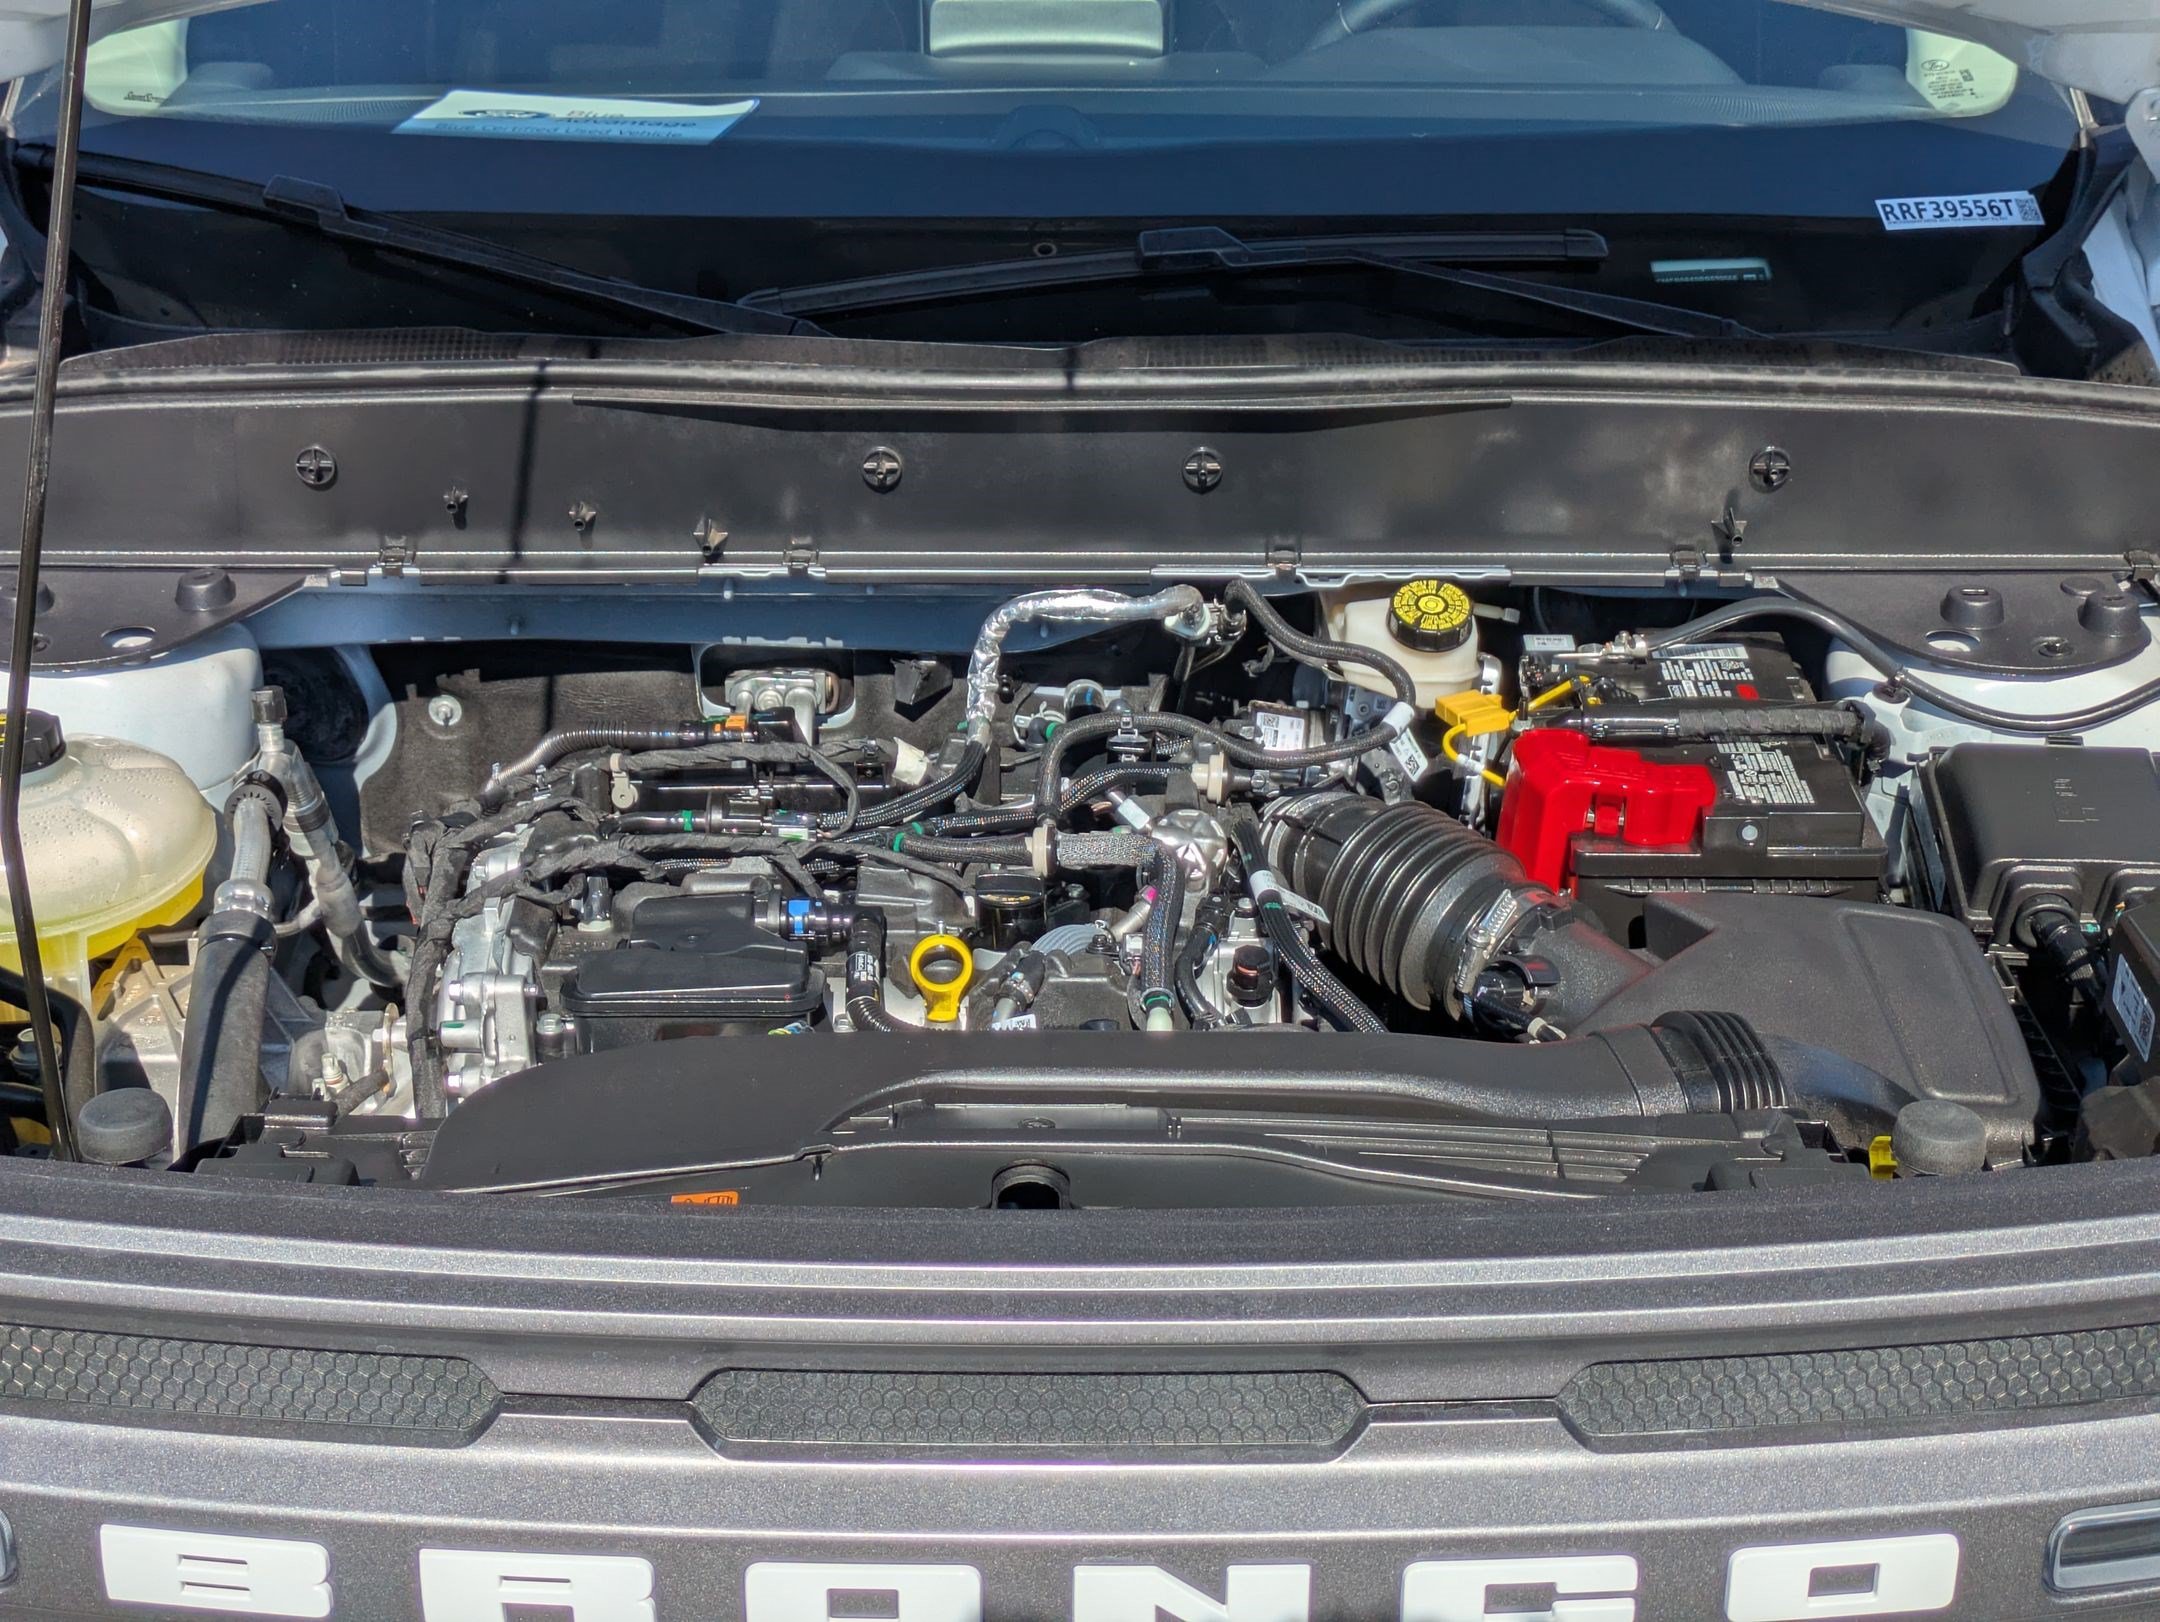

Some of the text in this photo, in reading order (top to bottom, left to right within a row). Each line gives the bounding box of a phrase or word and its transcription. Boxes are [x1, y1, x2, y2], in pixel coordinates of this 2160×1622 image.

[567, 110, 624, 118] Blue
[557, 117, 698, 128] Advantage
[435, 122, 476, 131] Blue
[482, 124, 559, 134] Certified
[618, 127, 684, 138] Vehicle
[1880, 198, 2015, 221] RRF39556T
